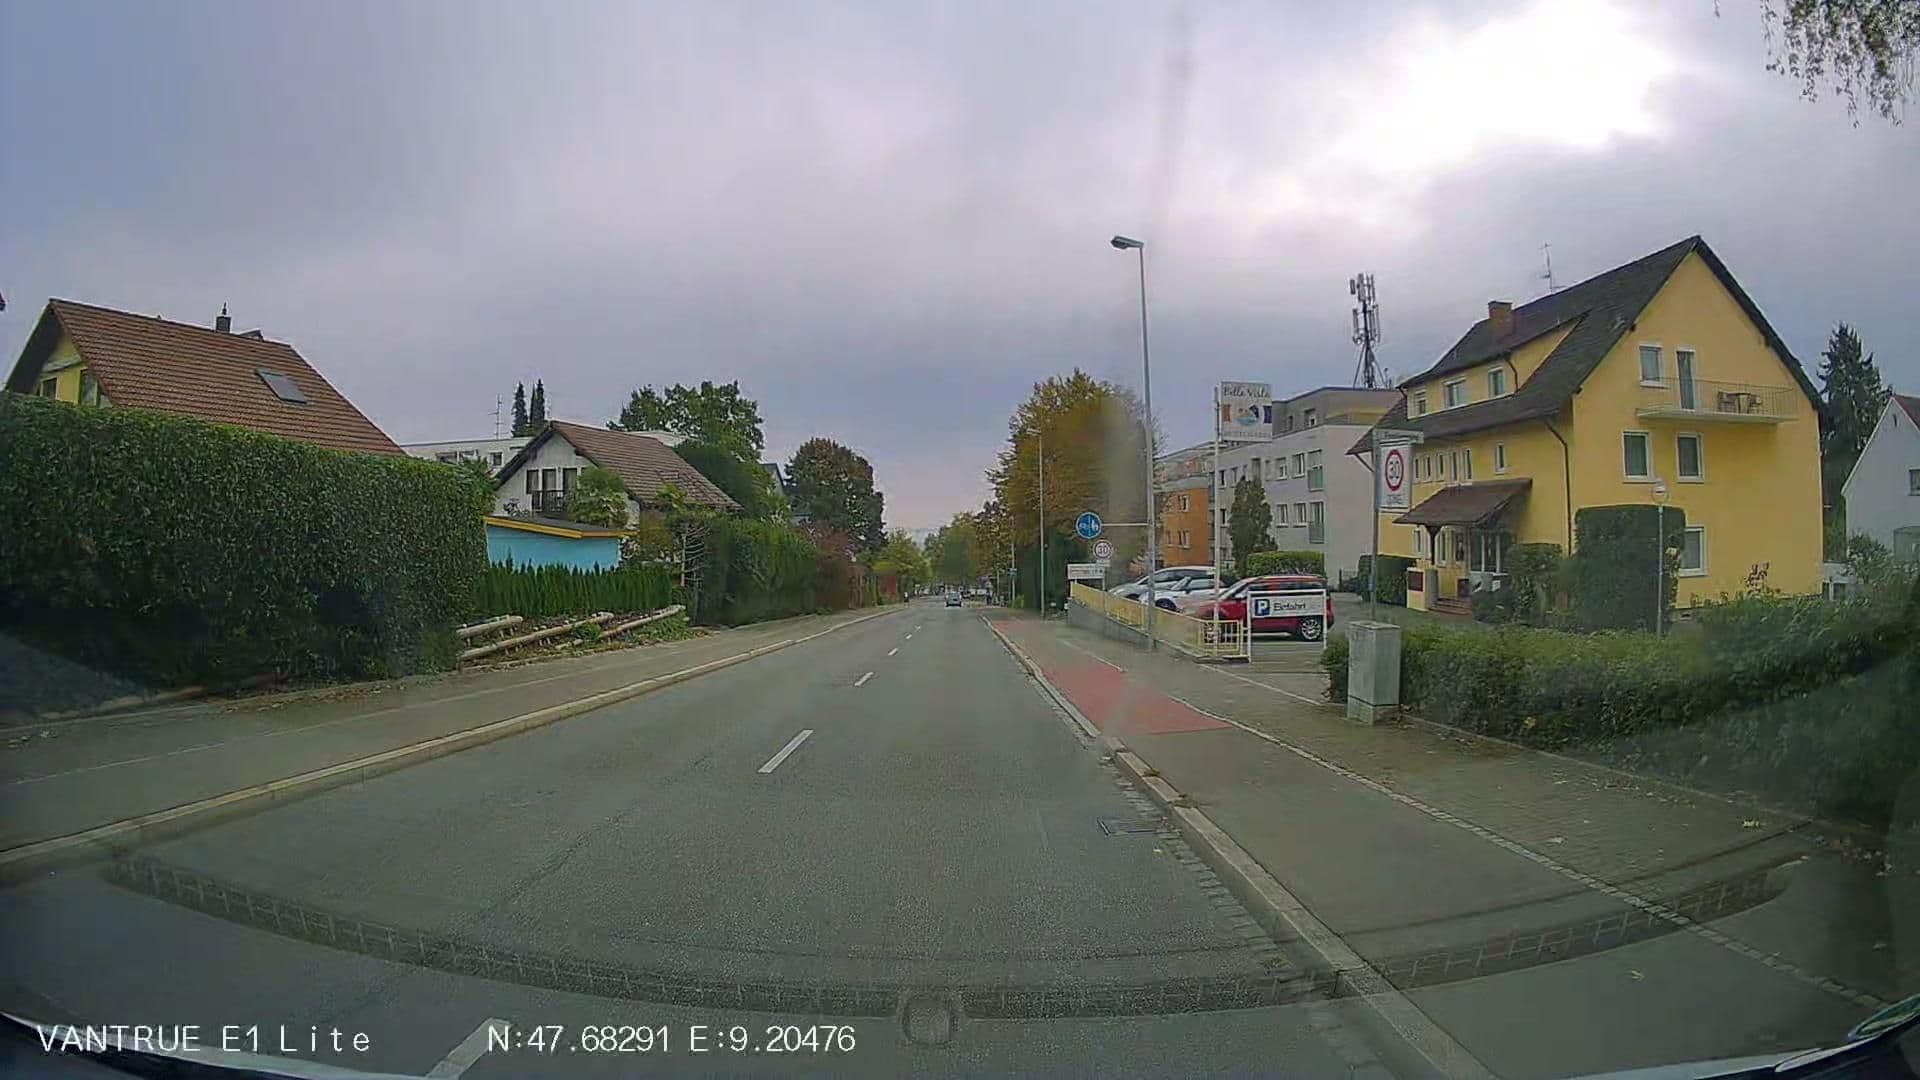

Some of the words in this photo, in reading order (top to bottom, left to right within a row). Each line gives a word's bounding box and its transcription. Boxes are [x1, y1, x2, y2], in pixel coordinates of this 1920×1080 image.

[1389, 460, 1400, 479] 30
[1097, 545, 1109, 554] 30
[1257, 601, 1269, 615] P
